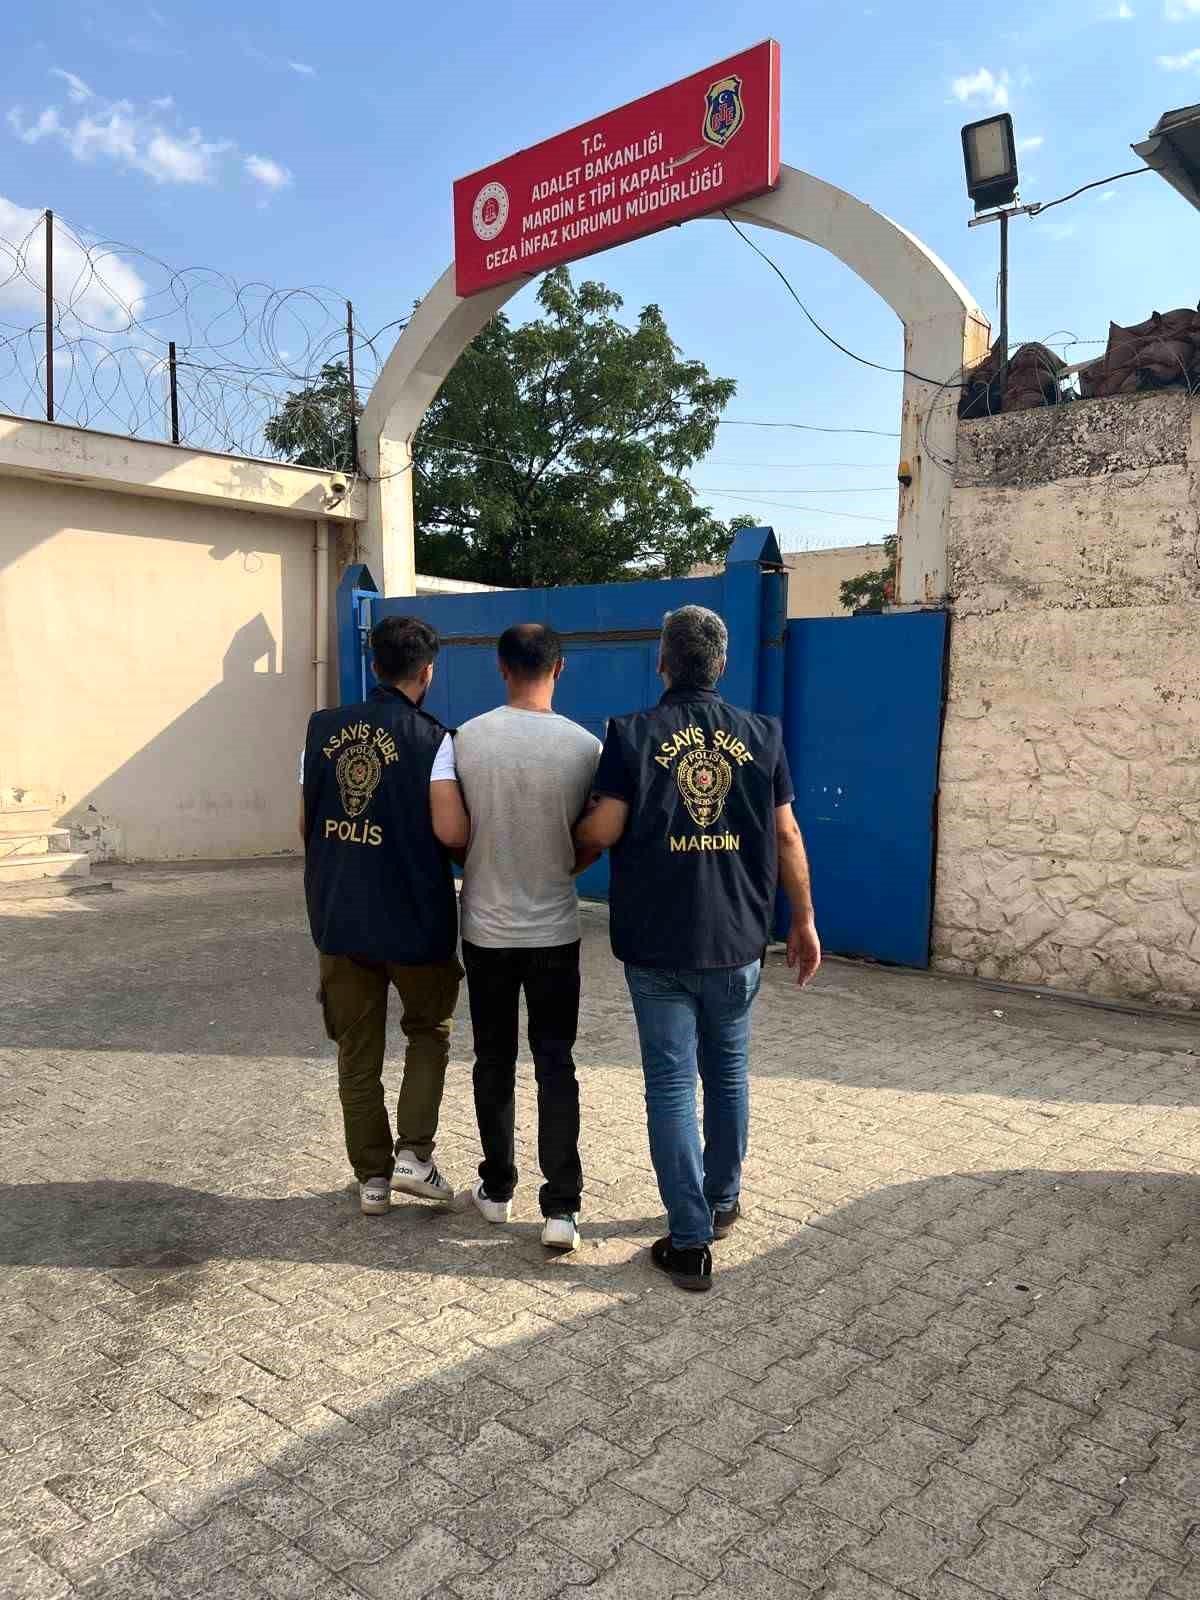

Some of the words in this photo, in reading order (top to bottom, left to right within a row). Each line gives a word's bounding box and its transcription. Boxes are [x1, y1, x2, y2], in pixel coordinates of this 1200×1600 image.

[531, 167, 582, 203] ADALET
[585, 130, 663, 181] BAKANLIĞI
[582, 133, 606, 156] T.C.
[486, 244, 517, 270] CEZA
[520, 229, 558, 257] İNFAZ
[562, 205, 621, 243] KURUMU
[625, 162, 723, 220] MÜDÜRLÜĞÜ
[522, 197, 574, 233] MARDİN
[578, 193, 586, 211] E
[589, 176, 616, 206] TİPİ
[654, 723, 706, 769] ASAYİŞ
[712, 730, 754, 766] ŞUBE
[325, 819, 383, 845] POLİS
[670, 831, 740, 852] MARDİN
